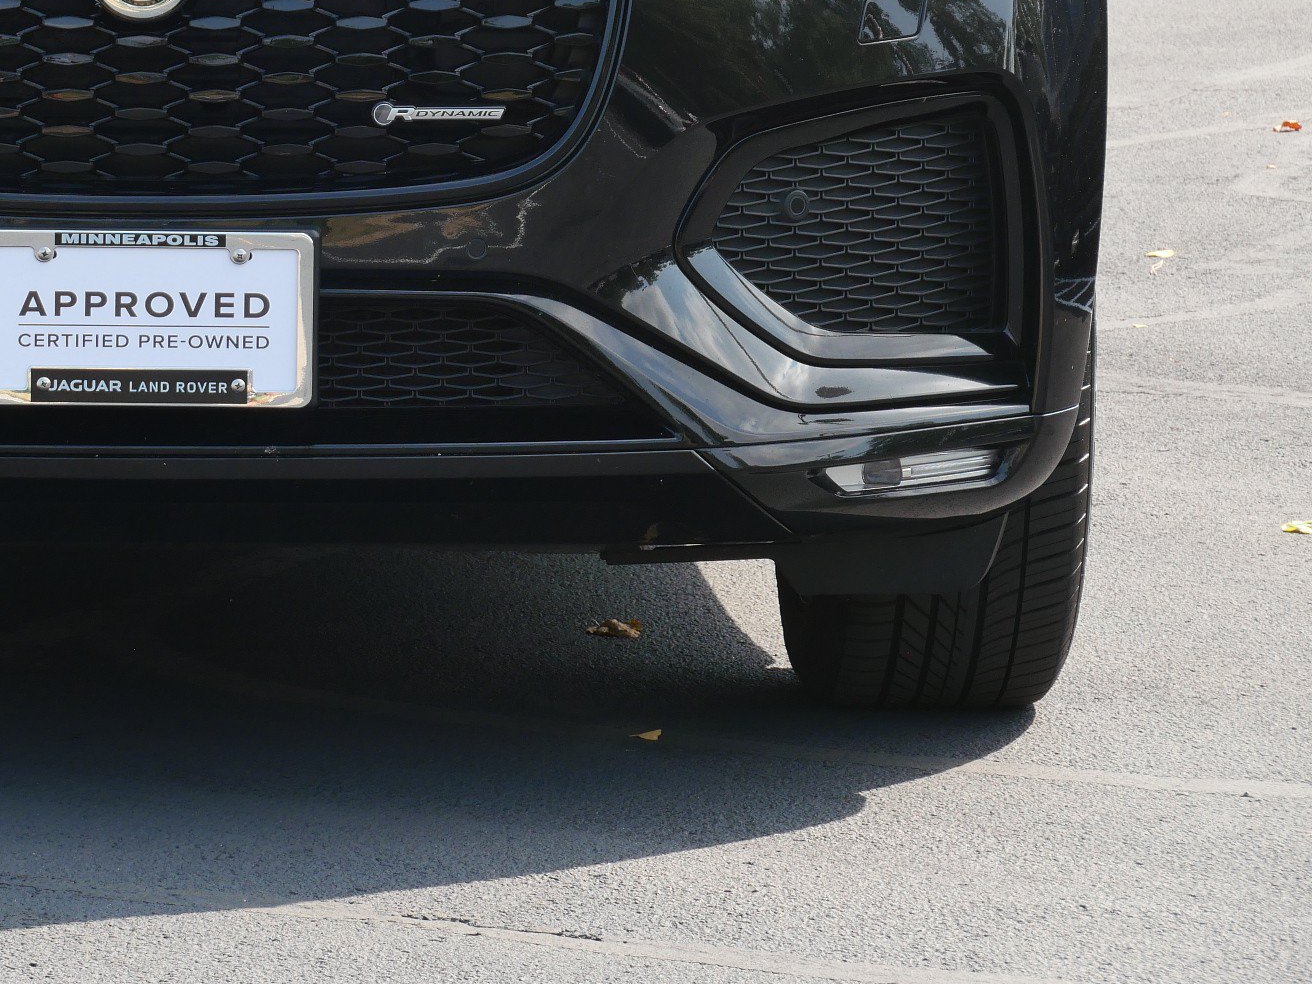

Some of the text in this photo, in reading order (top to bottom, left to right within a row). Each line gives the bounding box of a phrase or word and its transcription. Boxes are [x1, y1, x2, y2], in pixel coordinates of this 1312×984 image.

[60, 232, 220, 247] MINNEAPOLIS
[18, 290, 271, 319] APPROVED
[17, 332, 270, 350] CERTIFIED PRE-OWNED
[49, 379, 228, 394] JAGUAR LAND ROVER
